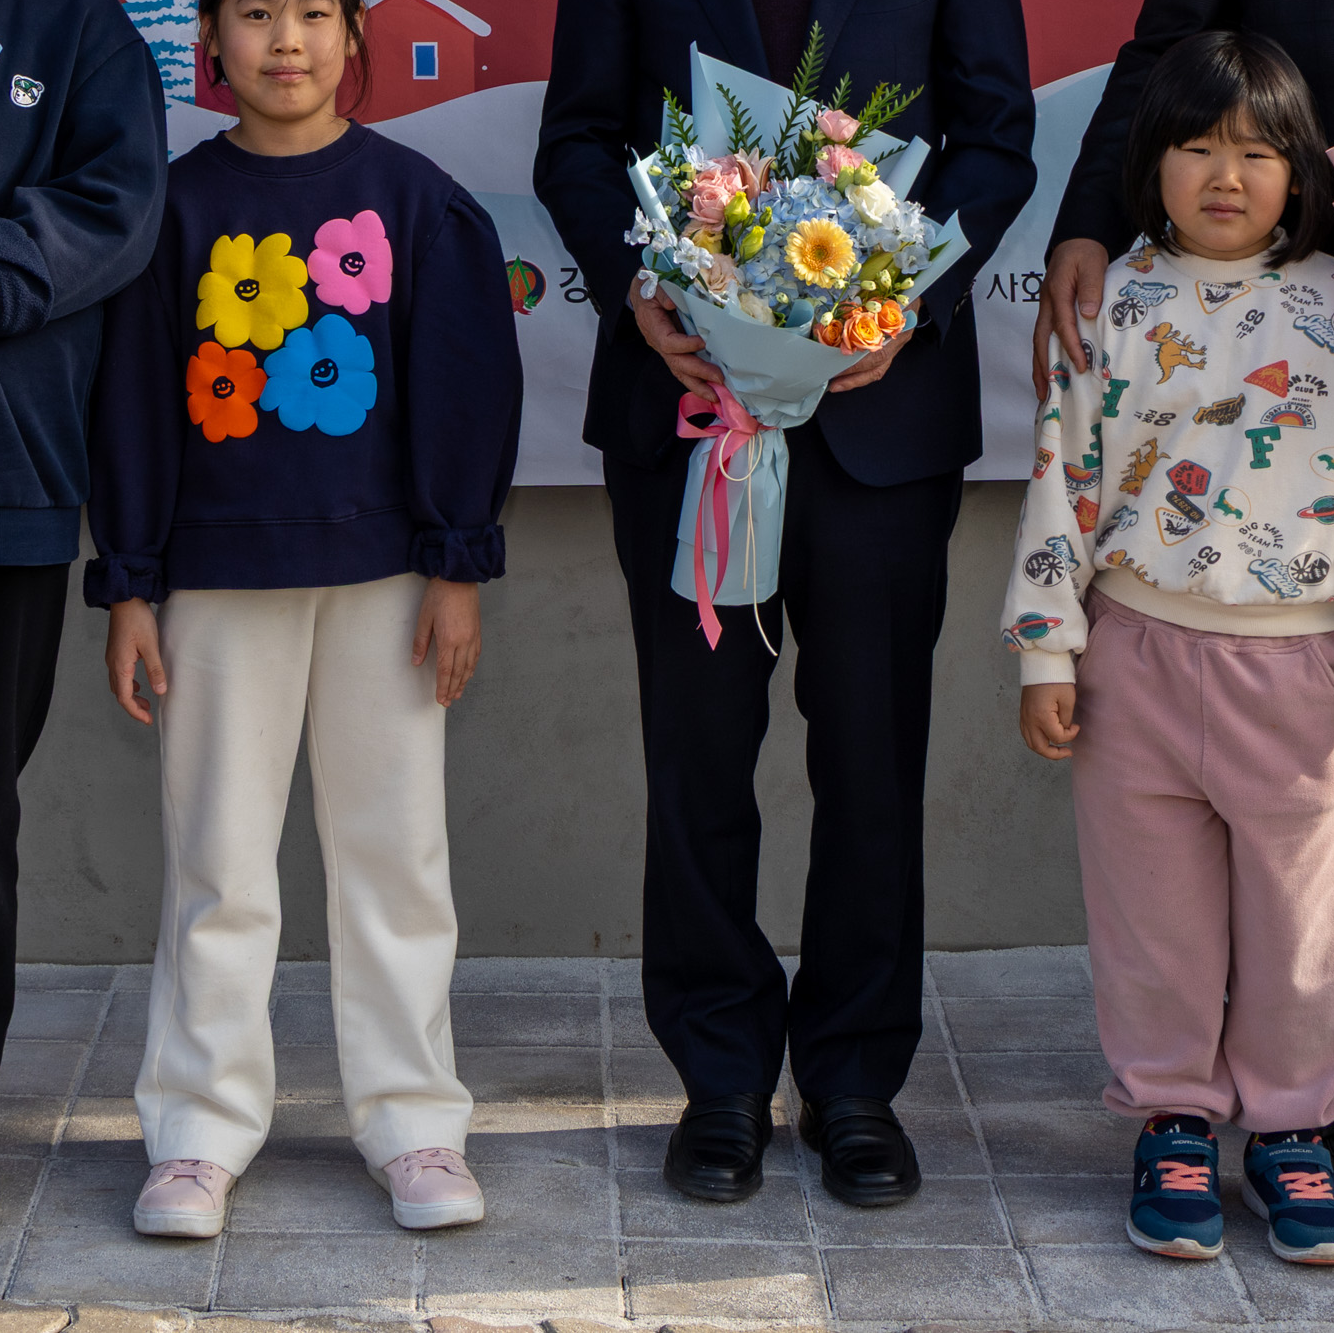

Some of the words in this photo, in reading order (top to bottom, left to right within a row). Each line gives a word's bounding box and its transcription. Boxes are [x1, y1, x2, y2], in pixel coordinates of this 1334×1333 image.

[1279, 283, 1297, 295] BIG
[1301, 285, 1324, 307] SMILE
[1288, 293, 1312, 307] TEAM
[1244, 308, 1266, 326] GO
[1235, 321, 1256, 334] FOR
[1235, 331, 1248, 340] IT
[1294, 386, 1315, 394] CLUB
[1304, 373, 1328, 397] TIME
[1141, 408, 1158, 424] FOR
[1153, 412, 1177, 427] GO
[1238, 522, 1259, 536] BIG
[1262, 523, 1284, 550] SMILE
[1247, 533, 1271, 549] TEAM
[1197, 545, 1222, 565] GO
[1187, 557, 1208, 573] FOR
[1187, 569, 1200, 578] IT
